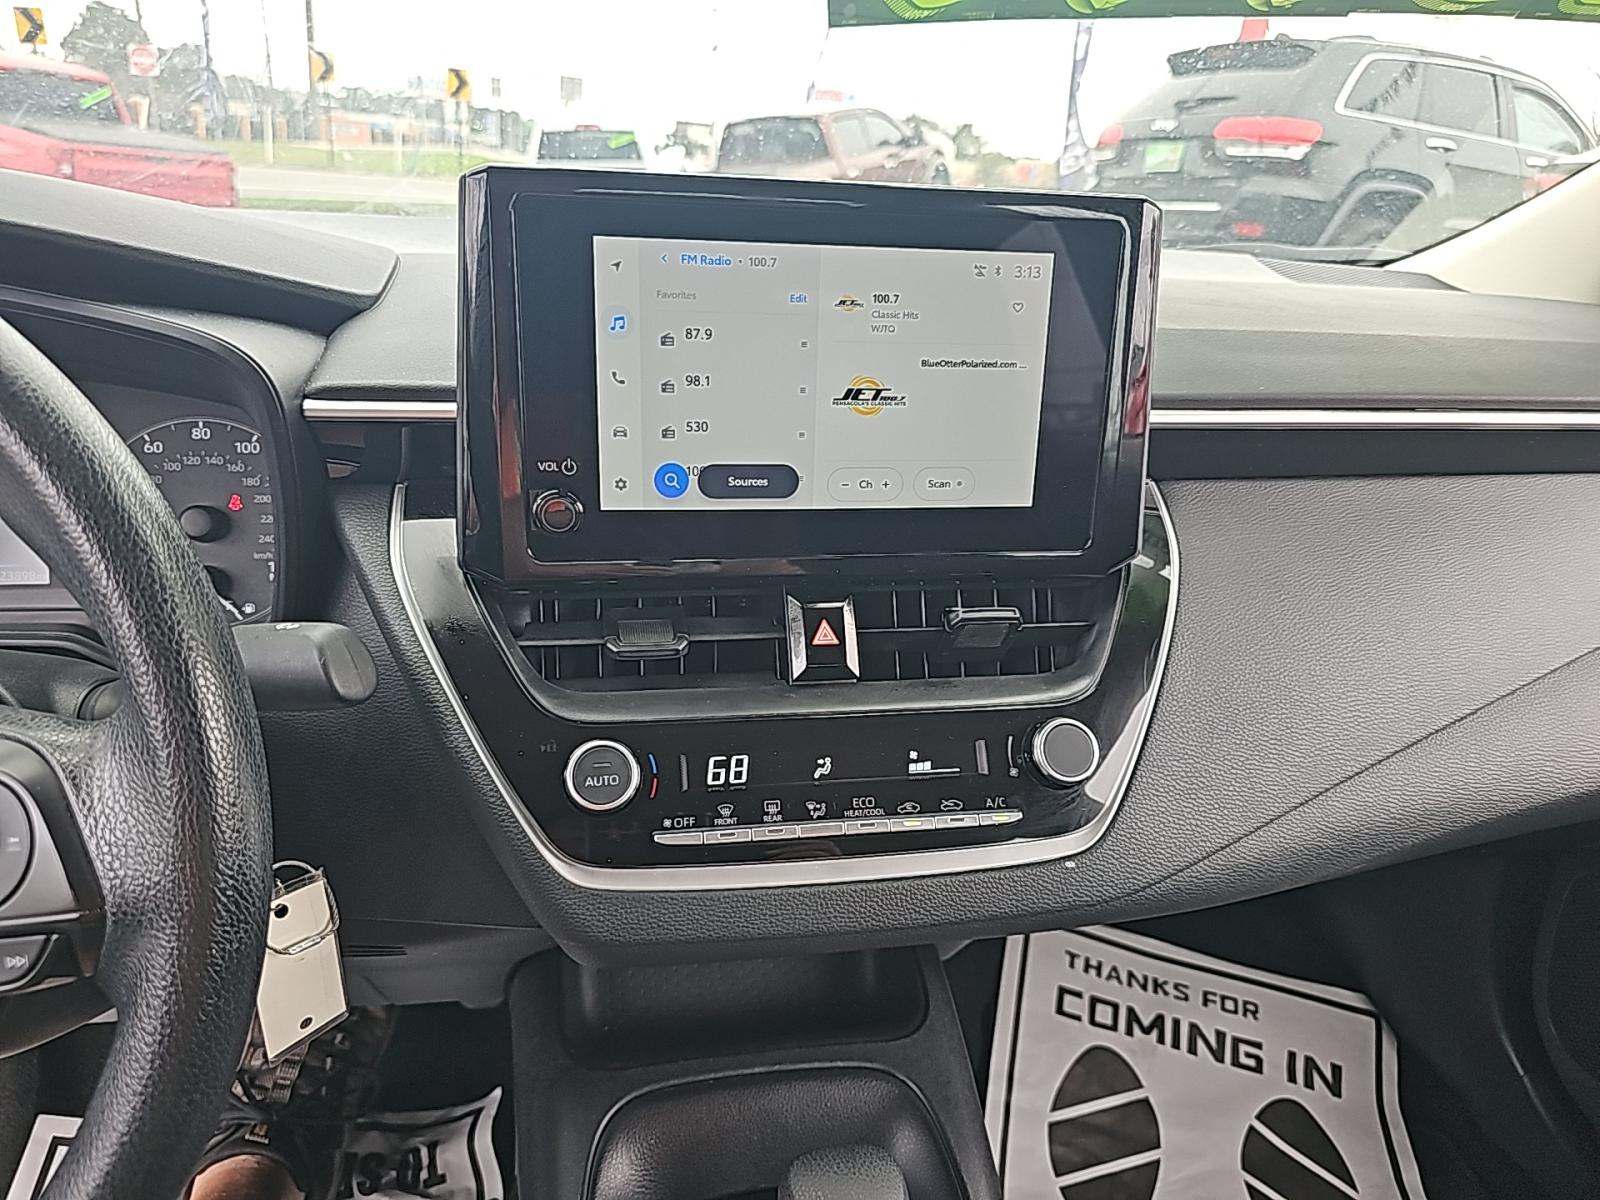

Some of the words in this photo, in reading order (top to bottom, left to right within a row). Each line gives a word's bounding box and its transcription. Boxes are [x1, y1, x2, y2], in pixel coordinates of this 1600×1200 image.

[680, 253, 698, 265] FM
[700, 254, 732, 266] Radio
[748, 257, 777, 268] 100.7
[1014, 265, 1041, 279] 3:13
[656, 290, 697, 300] Favorites
[789, 293, 808, 303] Edit
[872, 293, 900, 304] 100.7
[871, 310, 901, 319] Classic
[903, 311, 919, 320] Hits
[685, 327, 713, 340] 87.9
[920, 359, 1018, 370] BlueOtterPolarized.com
[685, 374, 711, 387] 98.1
[832, 387, 892, 402] JET
[685, 421, 709, 433] 530
[143, 441, 164, 453] 60
[191, 428, 211, 440] 80
[234, 442, 260, 454] 100
[537, 461, 560, 471] VOL
[163, 462, 182, 471] 100
[182, 456, 201, 465] 120
[204, 456, 224, 465] 140
[226, 463, 245, 472] 160
[241, 477, 261, 486] 180
[253, 494, 273, 503] 200
[727, 476, 769, 487] Sources
[859, 480, 873, 489] Ch
[927, 479, 951, 489] Scan
[706, 754, 749, 786] 68
[584, 774, 620, 787] AUTO
[852, 796, 875, 808] ECO
[985, 797, 1007, 808] A/C
[763, 814, 783, 823] REAR
[843, 807, 885, 818] HEAT/COOL
[673, 816, 696, 828] OFF
[713, 817, 738, 826] FRONT
[1064, 949, 1190, 1003] THANKS
[1200, 988, 1261, 1021] FOR
[1055, 983, 1264, 1076] COMING
[1285, 1049, 1343, 1100] IN
